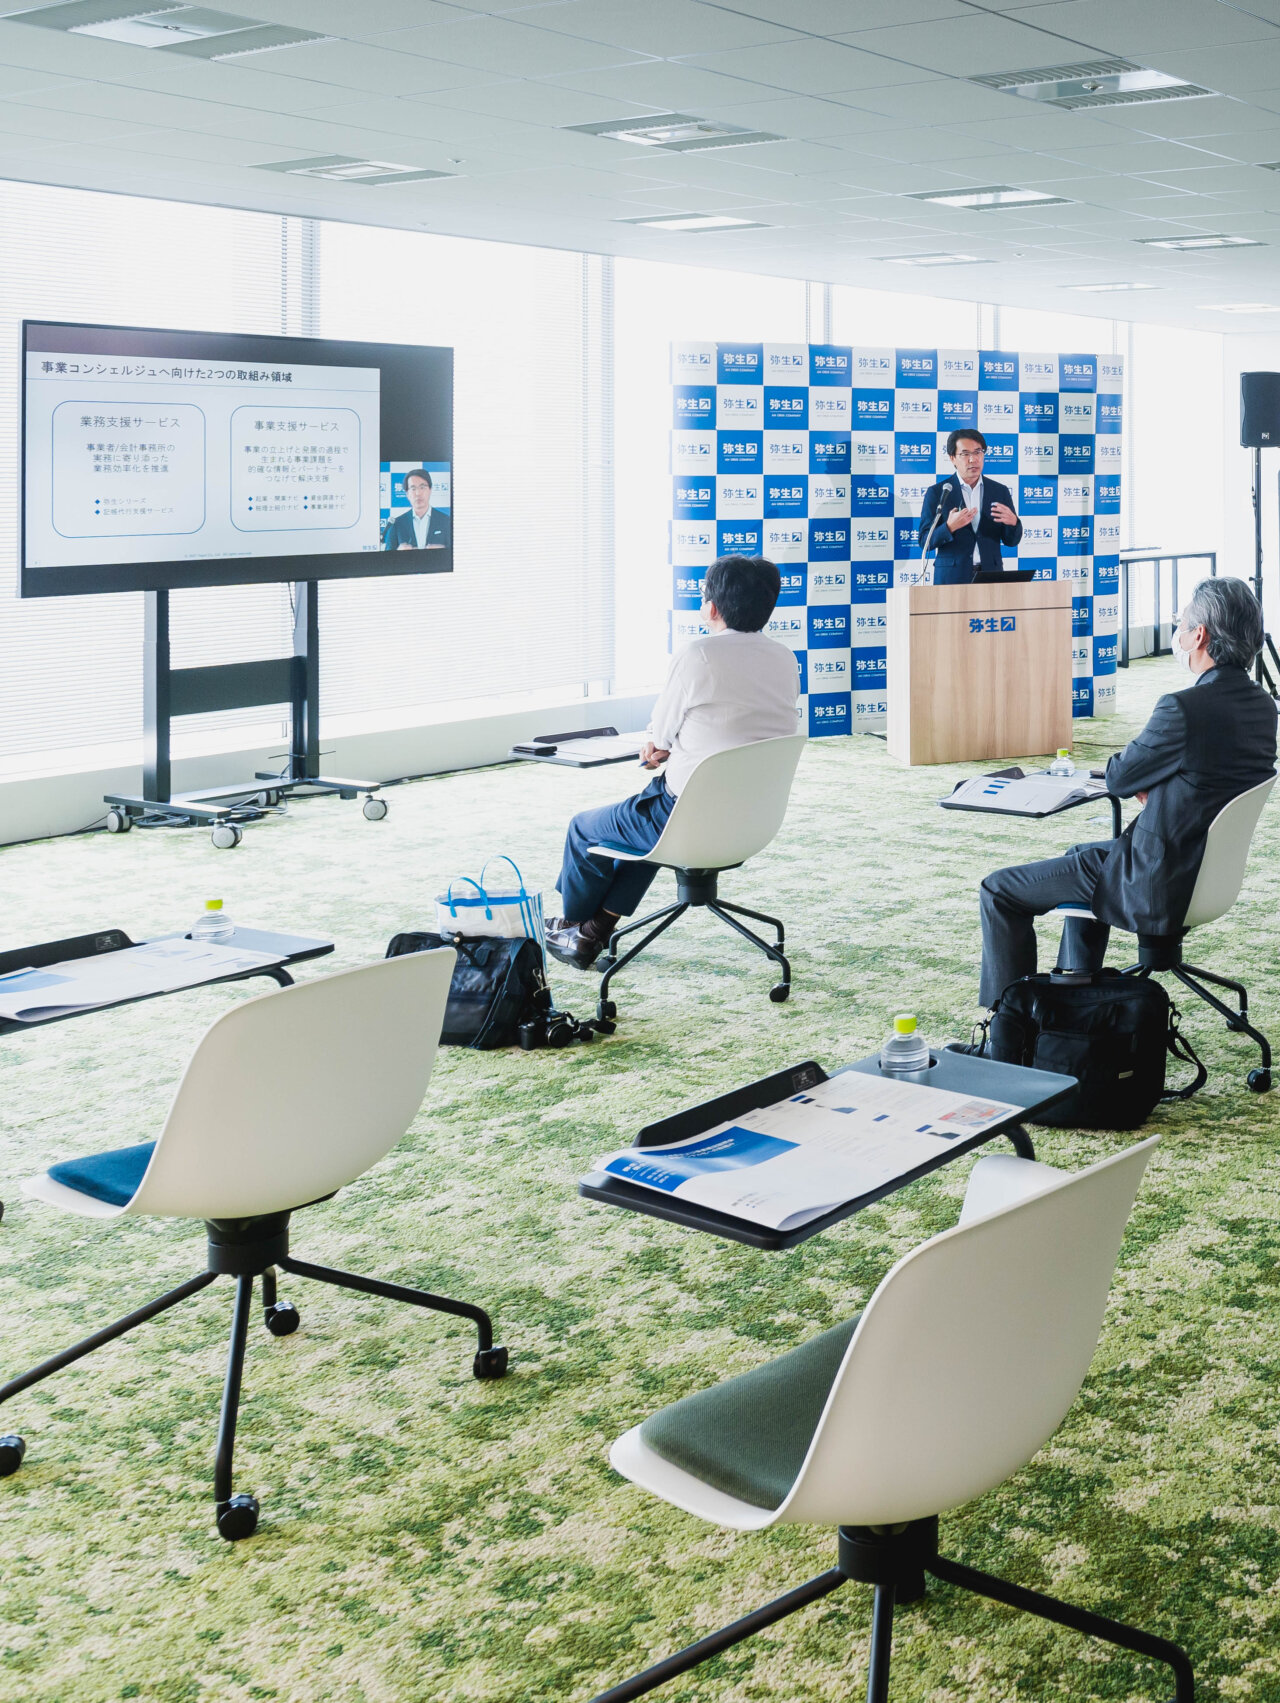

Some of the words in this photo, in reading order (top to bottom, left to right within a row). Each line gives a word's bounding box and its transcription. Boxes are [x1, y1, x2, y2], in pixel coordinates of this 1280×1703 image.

[679, 354, 698, 364] 弥生
[724, 354, 745, 364] 弥生
[771, 355, 791, 365] 弥生
[815, 356, 836, 367] 弥生
[859, 358, 878, 368] 弥生
[902, 359, 921, 369] 弥生
[944, 361, 963, 370] 弥生
[984, 362, 1003, 372] 弥生
[1025, 364, 1043, 373] 弥生
[41, 361, 292, 383] 事業コンシェルジュへ向けた2つの取組み領域
[1064, 365, 1082, 374] 弥生
[1102, 366, 1118, 375] 弥生
[677, 399, 698, 410] 弥生
[724, 400, 745, 408] 弥生
[770, 400, 791, 410] 弥生
[816, 400, 835, 410] 弥生
[858, 401, 878, 411] 弥生
[901, 402, 920, 411] 弥生
[943, 403, 962, 412] 弥生
[984, 405, 1002, 413] 弥生
[1024, 405, 1043, 414] 弥生
[1065, 406, 1082, 414] 弥生
[1102, 406, 1118, 415] 弥生
[80, 416, 180, 428] 業務支援サービス
[255, 421, 339, 432] 事業支援サービス
[678, 445, 697, 454] 弥生
[723, 444, 745, 454] 弥生
[770, 444, 790, 453] 弥生
[815, 444, 835, 454] 弥生
[858, 445, 877, 454] 弥生
[900, 445, 919, 455] 弥生
[1025, 446, 1043, 455] 弥生
[1064, 446, 1081, 456] 弥生
[1101, 447, 1116, 455] 弥生
[677, 489, 698, 500] 弥生
[723, 489, 744, 498] 弥生
[770, 488, 791, 498] 弥生
[815, 488, 834, 497] 弥生
[857, 488, 877, 497] 弥生
[900, 488, 920, 497] 弥生
[1024, 487, 1042, 497] 弥生
[1064, 488, 1080, 496] 弥生
[1100, 487, 1116, 496] 弥生
[814, 532, 834, 541] 弥生
[857, 531, 876, 540] 弥生
[900, 530, 919, 540] 弥生
[1024, 529, 1042, 538] 弥生
[1063, 528, 1080, 537] 弥生
[1100, 528, 1114, 536] 弥生
[678, 534, 697, 544] 弥生
[723, 533, 744, 543] 弥生
[770, 533, 790, 542] 弥生
[1063, 568, 1079, 578] 弥生
[1099, 567, 1114, 577] 弥生
[814, 576, 833, 585] 弥生
[857, 574, 876, 584] 弥生
[900, 574, 918, 582] 弥生
[677, 579, 698, 590] 弥生
[1099, 608, 1114, 616] 弥生
[769, 621, 789, 630] 弥生
[813, 618, 834, 629] 弥生
[857, 617, 876, 627] 弥生
[969, 617, 999, 633] 弥生
[678, 625, 697, 634] 弥生
[1098, 648, 1113, 658] 弥生
[814, 663, 834, 672] 弥生
[857, 660, 876, 671] 弥生
[1098, 689, 1112, 697] 弥生
[815, 706, 835, 717] 弥生
[857, 704, 876, 713] 弥生
